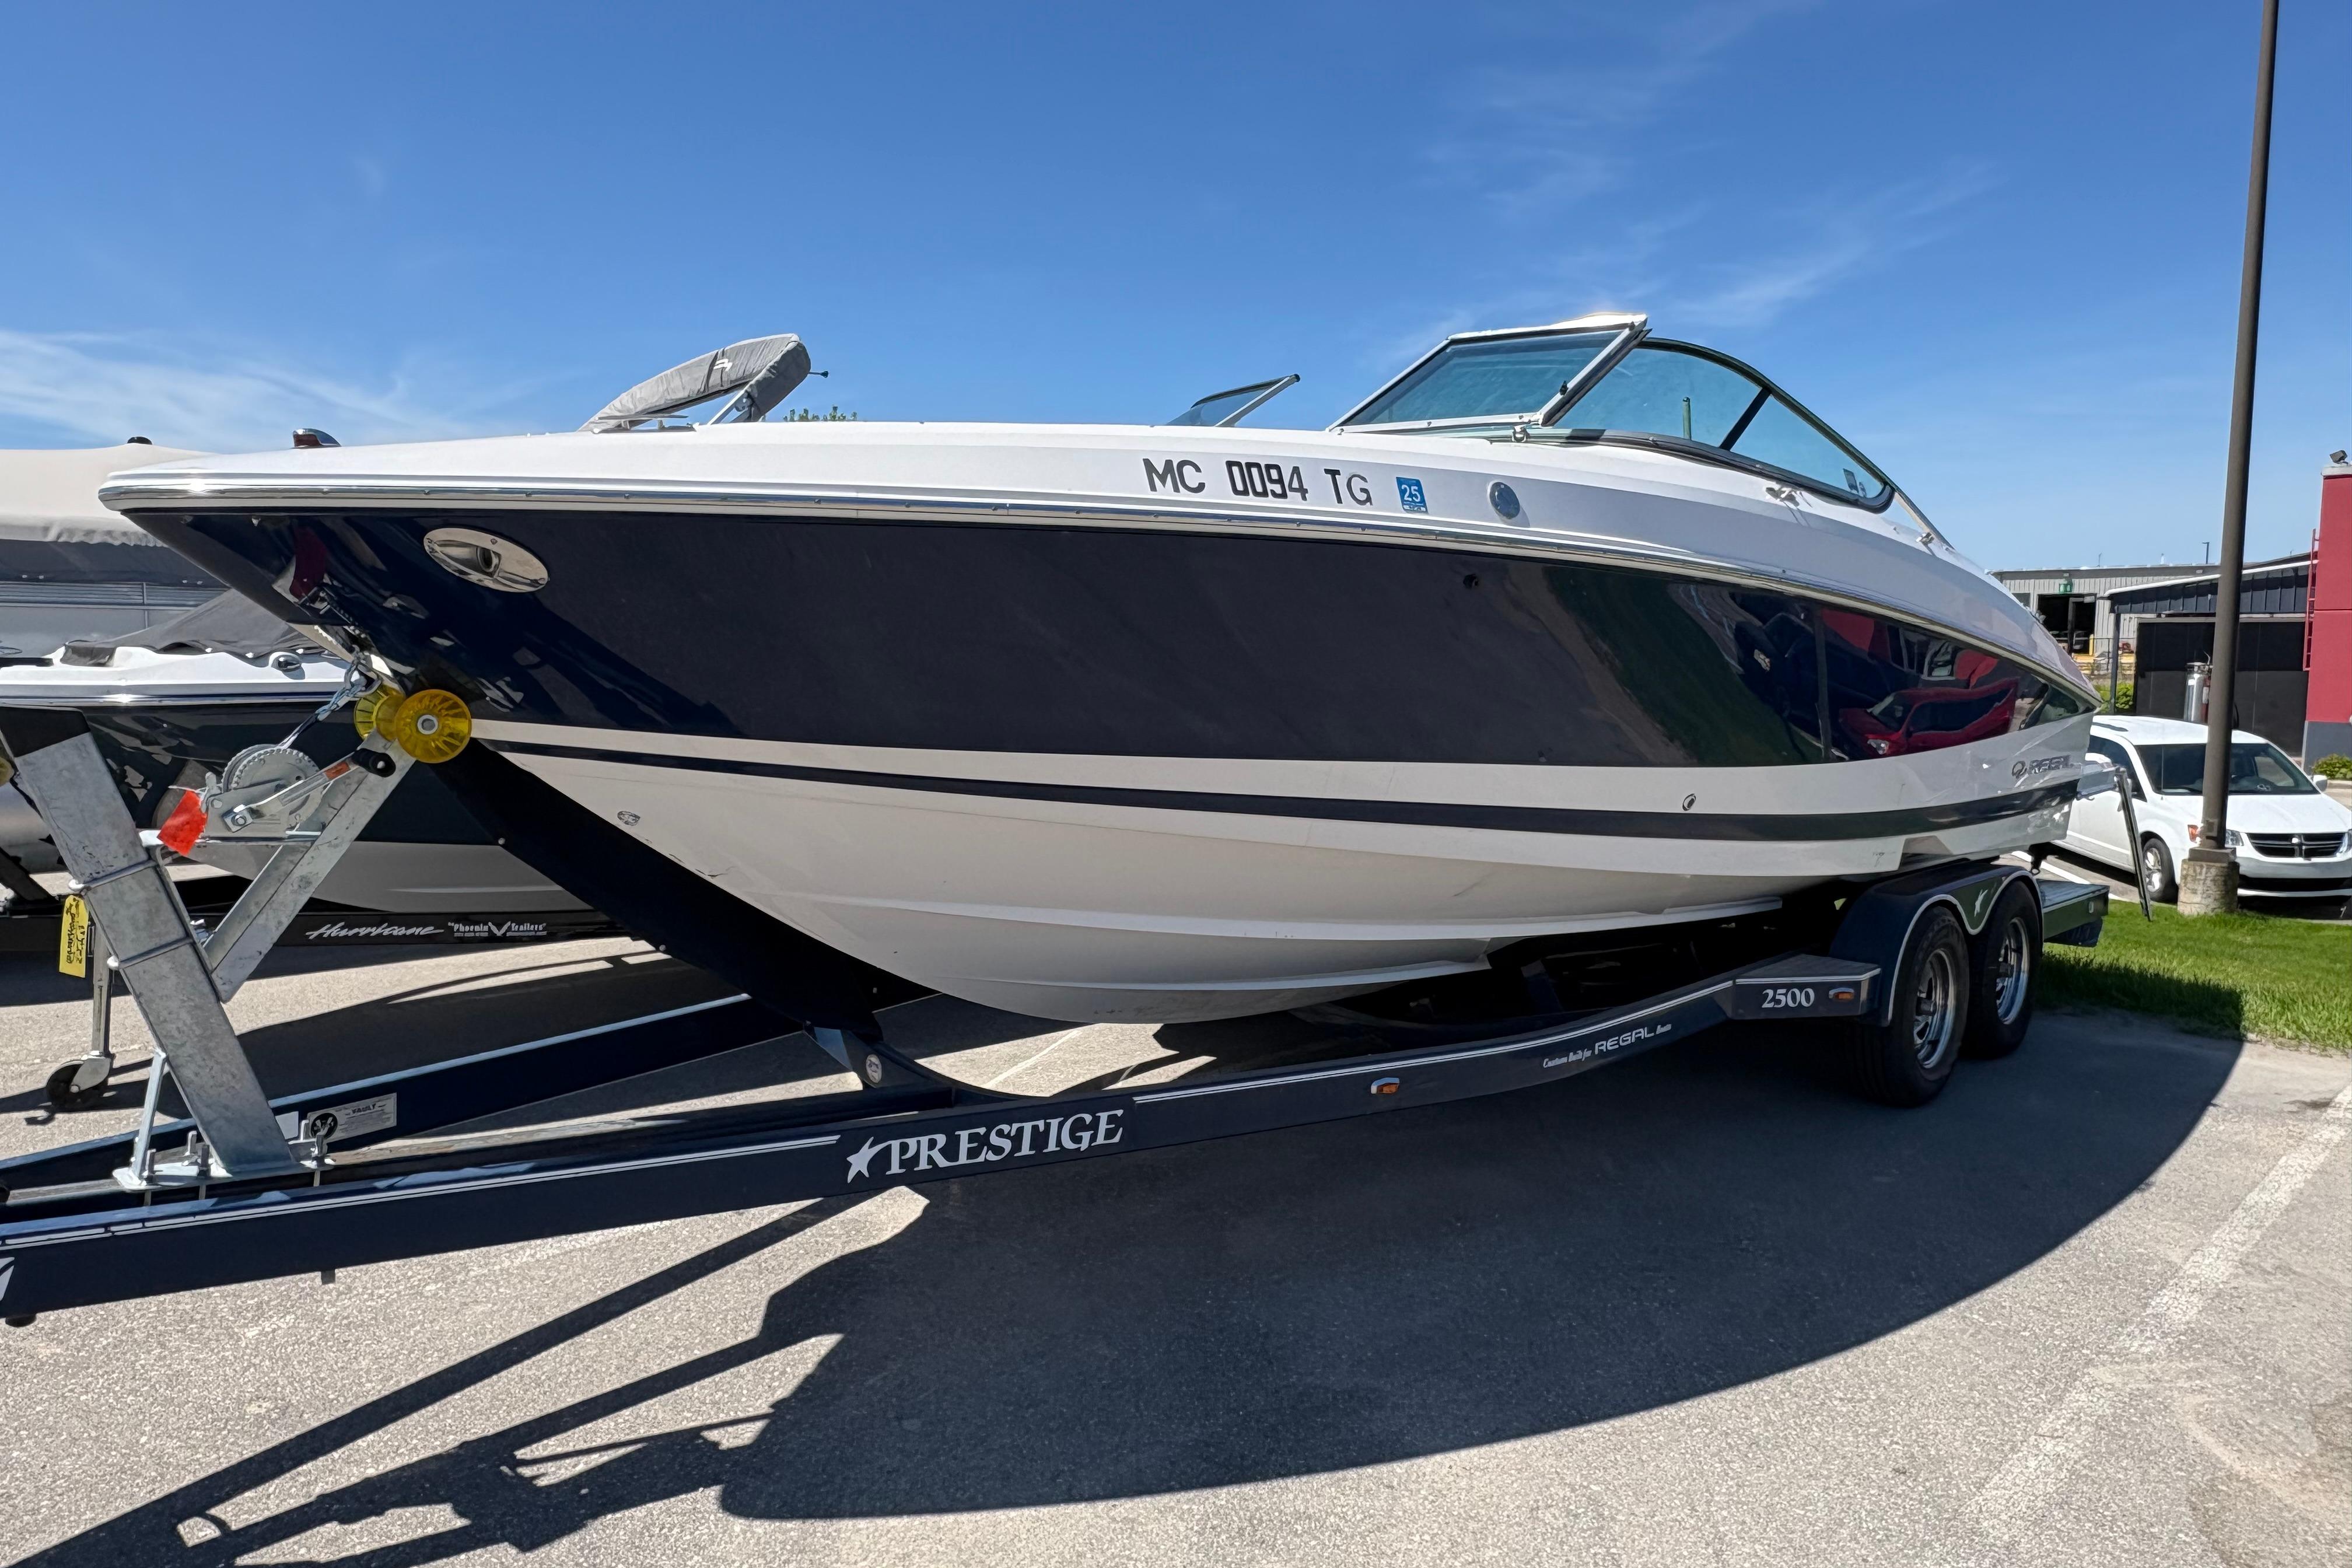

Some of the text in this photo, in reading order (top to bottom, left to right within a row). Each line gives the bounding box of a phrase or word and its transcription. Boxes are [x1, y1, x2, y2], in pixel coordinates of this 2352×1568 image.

[1143, 458, 1373, 506] MC 0094 TG
[1401, 484, 1421, 502] 25
[306, 922, 444, 939] Hurricane
[1762, 988, 1815, 1009] 2500
[1595, 1026, 1654, 1055] REGAL
[886, 1109, 1124, 1175] PRESTIGE
